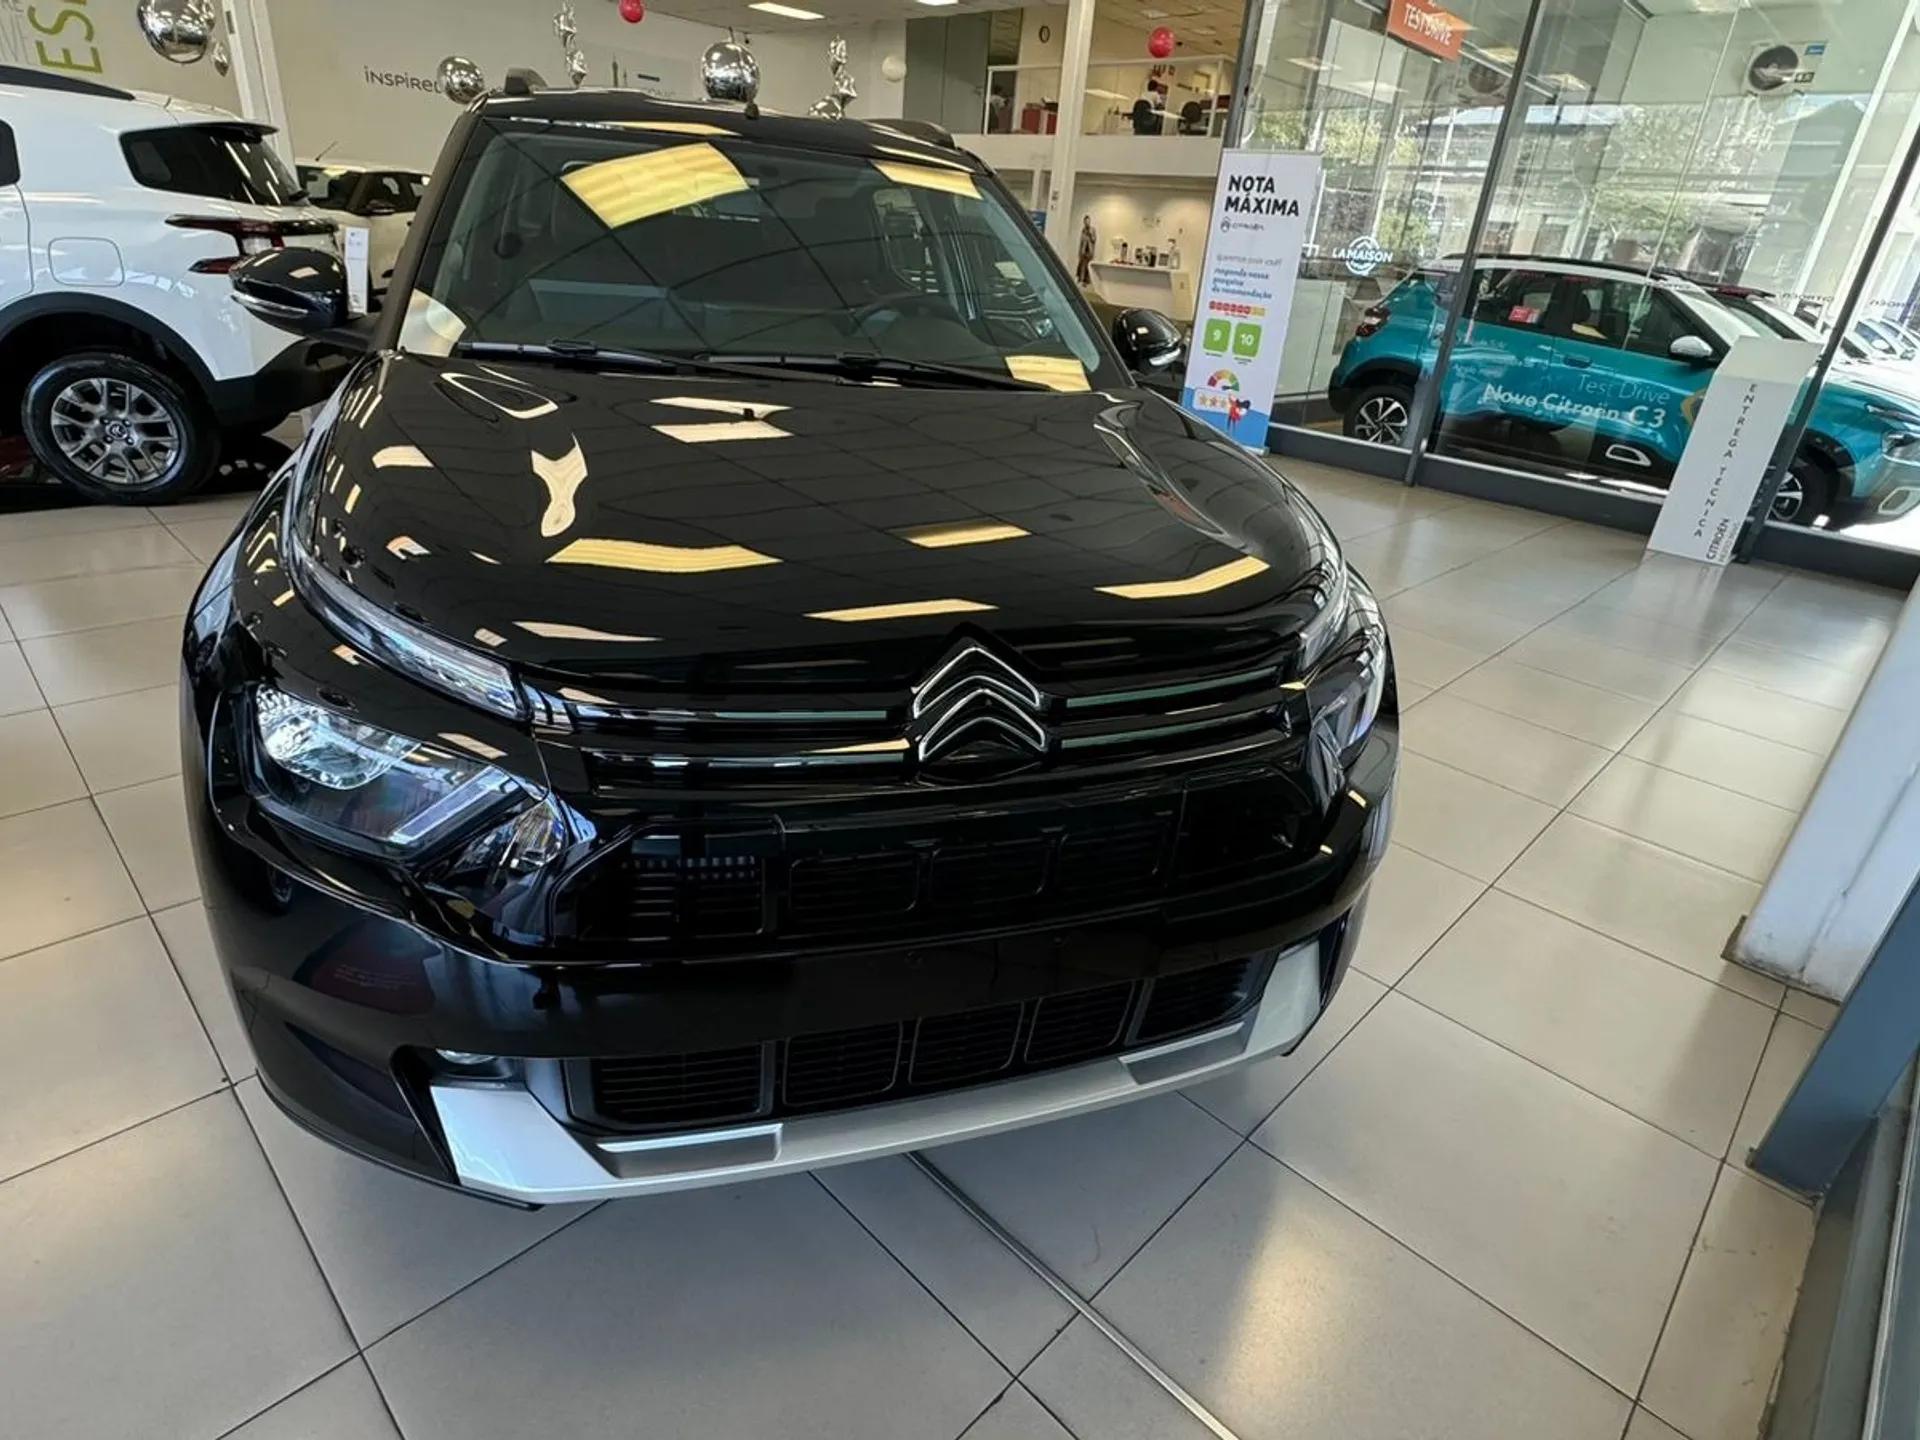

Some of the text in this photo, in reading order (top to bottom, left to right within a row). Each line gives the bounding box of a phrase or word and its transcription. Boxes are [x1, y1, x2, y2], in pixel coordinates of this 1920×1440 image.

[27, 0, 103, 73] ES
[1227, 175, 1276, 194] NOTA
[1223, 192, 1300, 217] MÁXIMA
[1213, 328, 1222, 342] 9
[1240, 333, 1255, 347] 10
[1482, 383, 1538, 408] Novo
[1578, 373, 1671, 406] Test Drive
[1723, 383, 1758, 459] ENTREGA
